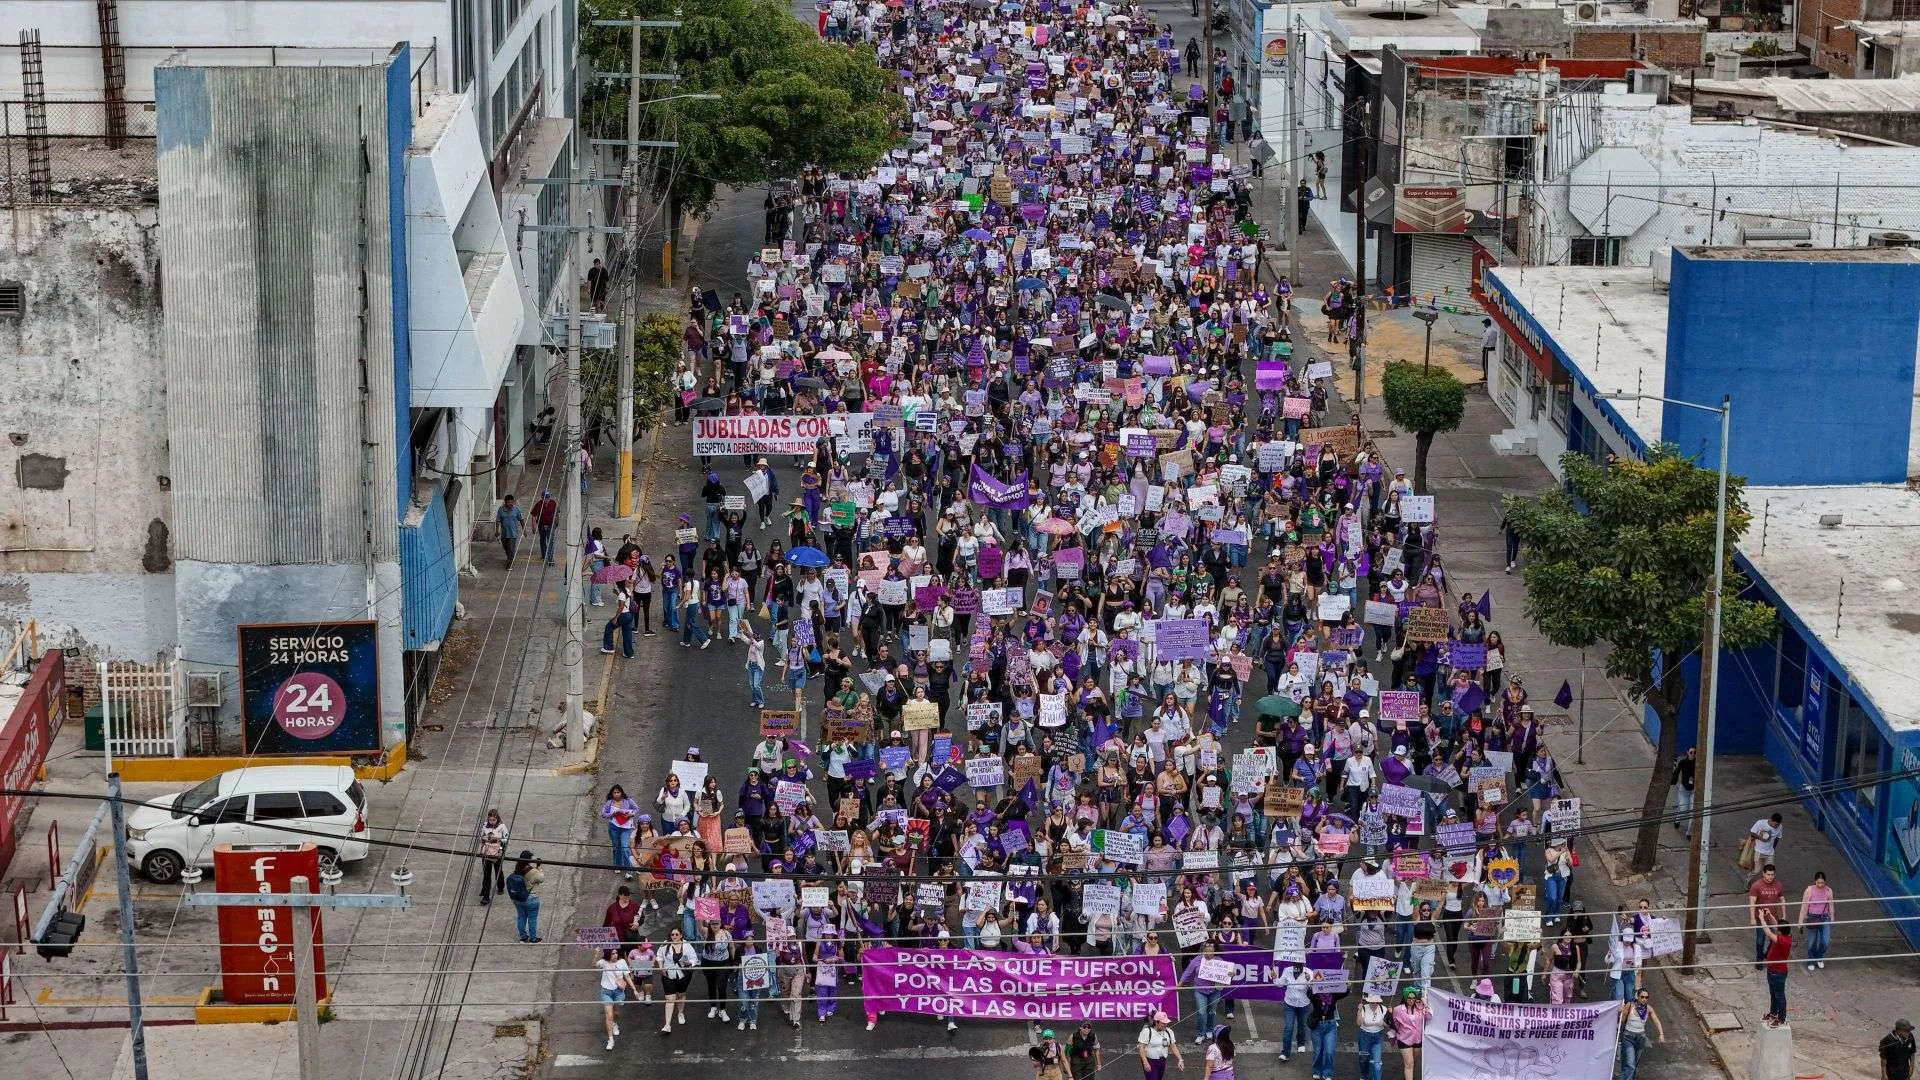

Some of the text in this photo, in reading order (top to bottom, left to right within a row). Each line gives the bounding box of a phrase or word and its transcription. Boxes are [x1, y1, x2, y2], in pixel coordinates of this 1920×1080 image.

[697, 418, 791, 439] JUBILADAS
[696, 442, 725, 454] RESPETO
[733, 442, 767, 453] DERECHOS
[769, 443, 777, 453] DE
[779, 443, 815, 453] JUBILADAS
[270, 636, 344, 650] SERVICIO
[270, 650, 349, 664] 24 HORAS
[286, 683, 332, 713] 24
[286, 716, 335, 728] HORAS
[897, 952, 1161, 978] POR LAS QUE FUERON,
[1233, 963, 1258, 982] DE
[894, 973, 1166, 997] POR LAS QUE ESTAMOS
[898, 995, 1164, 1019] Y POR LAS QUE VIENEN
[1449, 998, 1466, 1011] HOY
[1469, 1001, 1482, 1013] NO
[1518, 1005, 1548, 1018] TODAS
[1551, 1007, 1600, 1020] NUESTRAS
[1452, 1010, 1593, 1030] VOCES JUNTAS PORQUE DESDE
[1447, 1022, 1595, 1040] LA TUMBA NO SE PUEDE GRITAR
